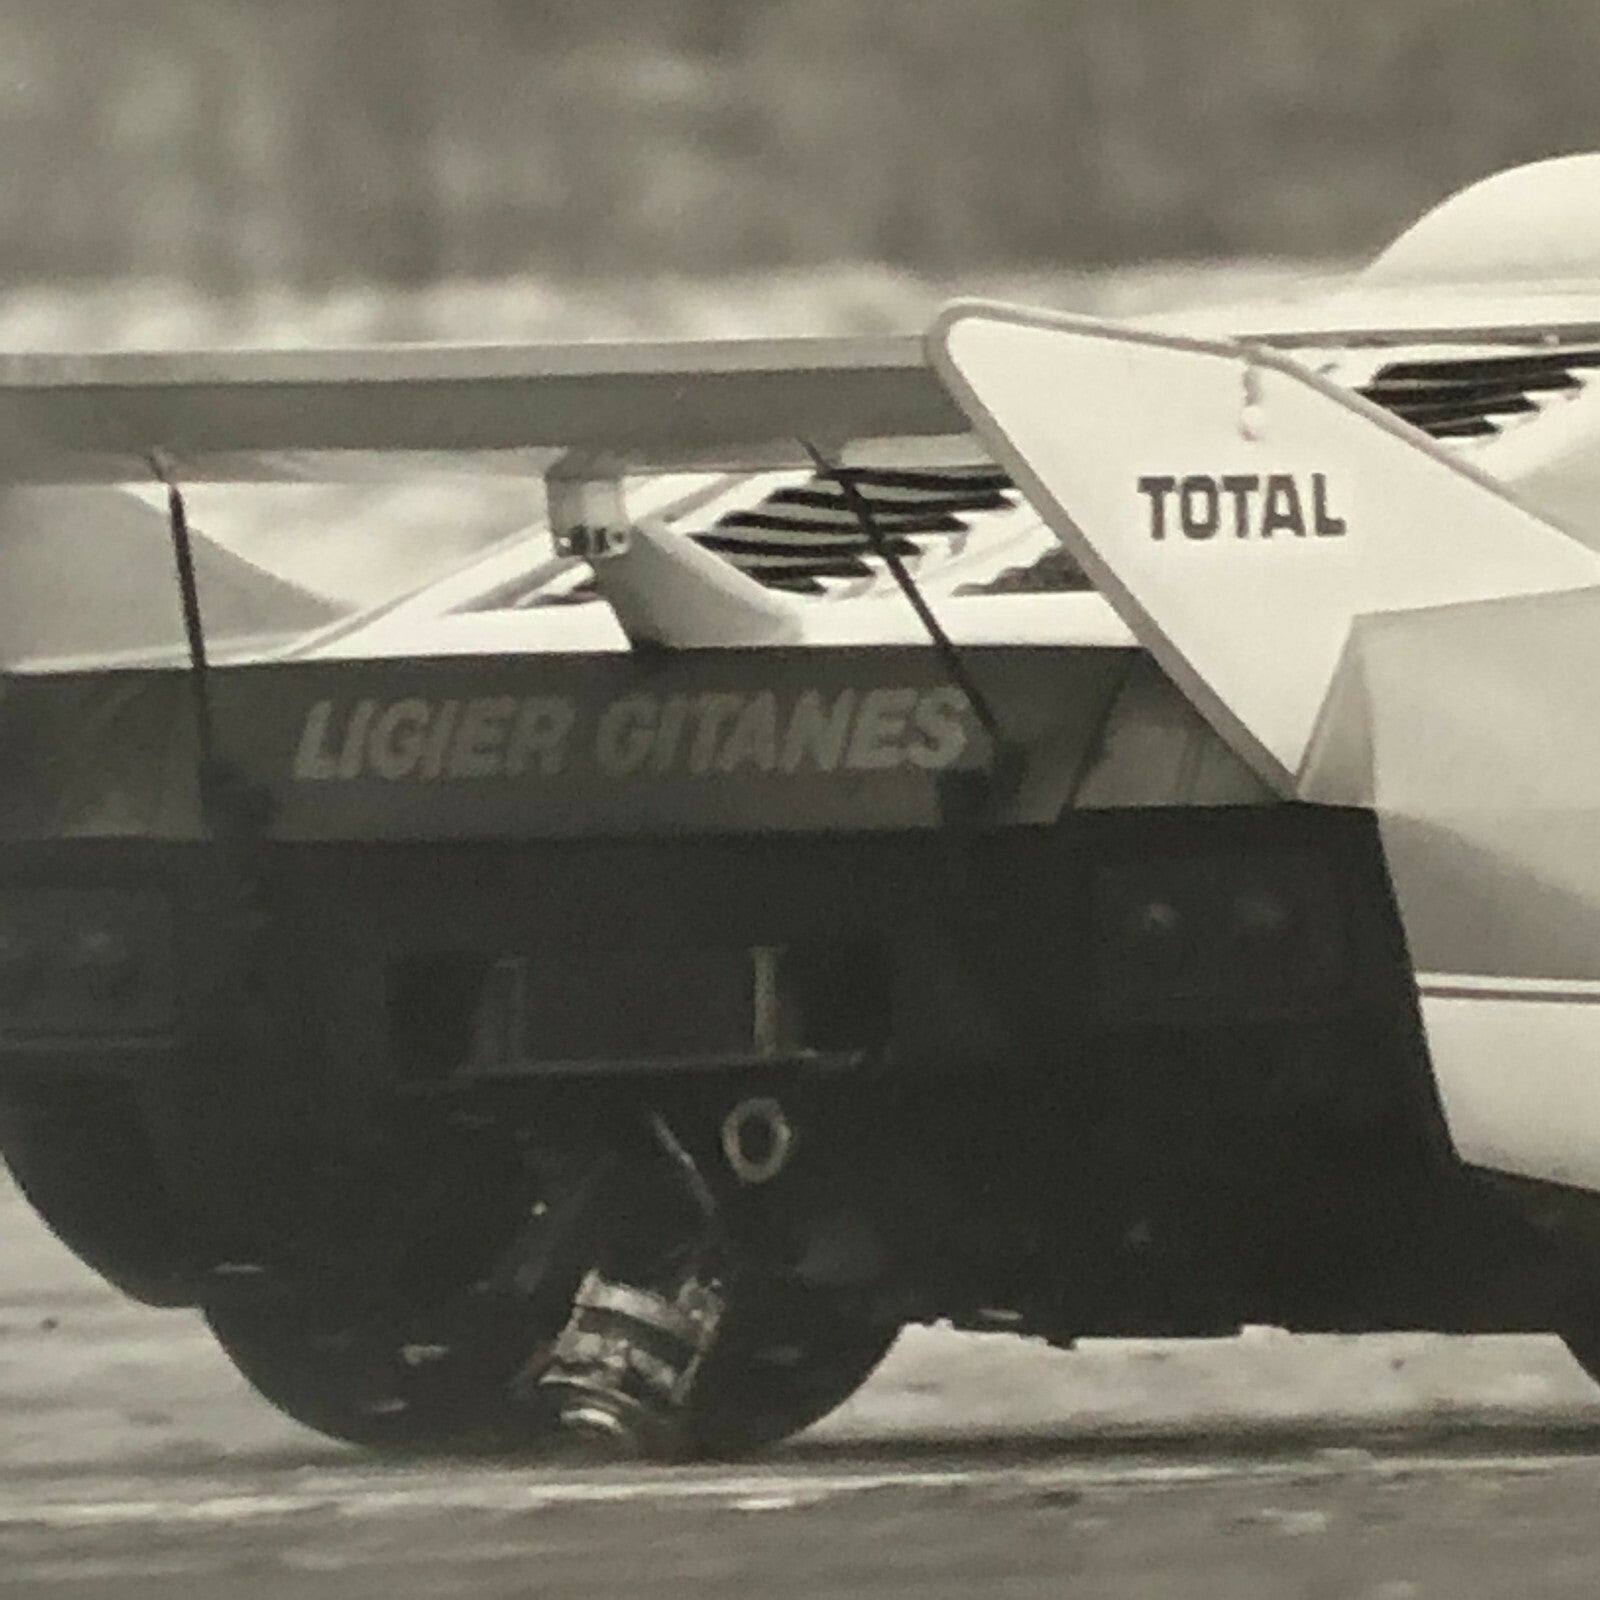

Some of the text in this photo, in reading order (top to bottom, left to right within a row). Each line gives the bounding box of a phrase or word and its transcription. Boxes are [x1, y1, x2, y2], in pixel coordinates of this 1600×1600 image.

[1137, 473, 1347, 540] TOTAL
[294, 686, 968, 781] LIGIER GITANES
